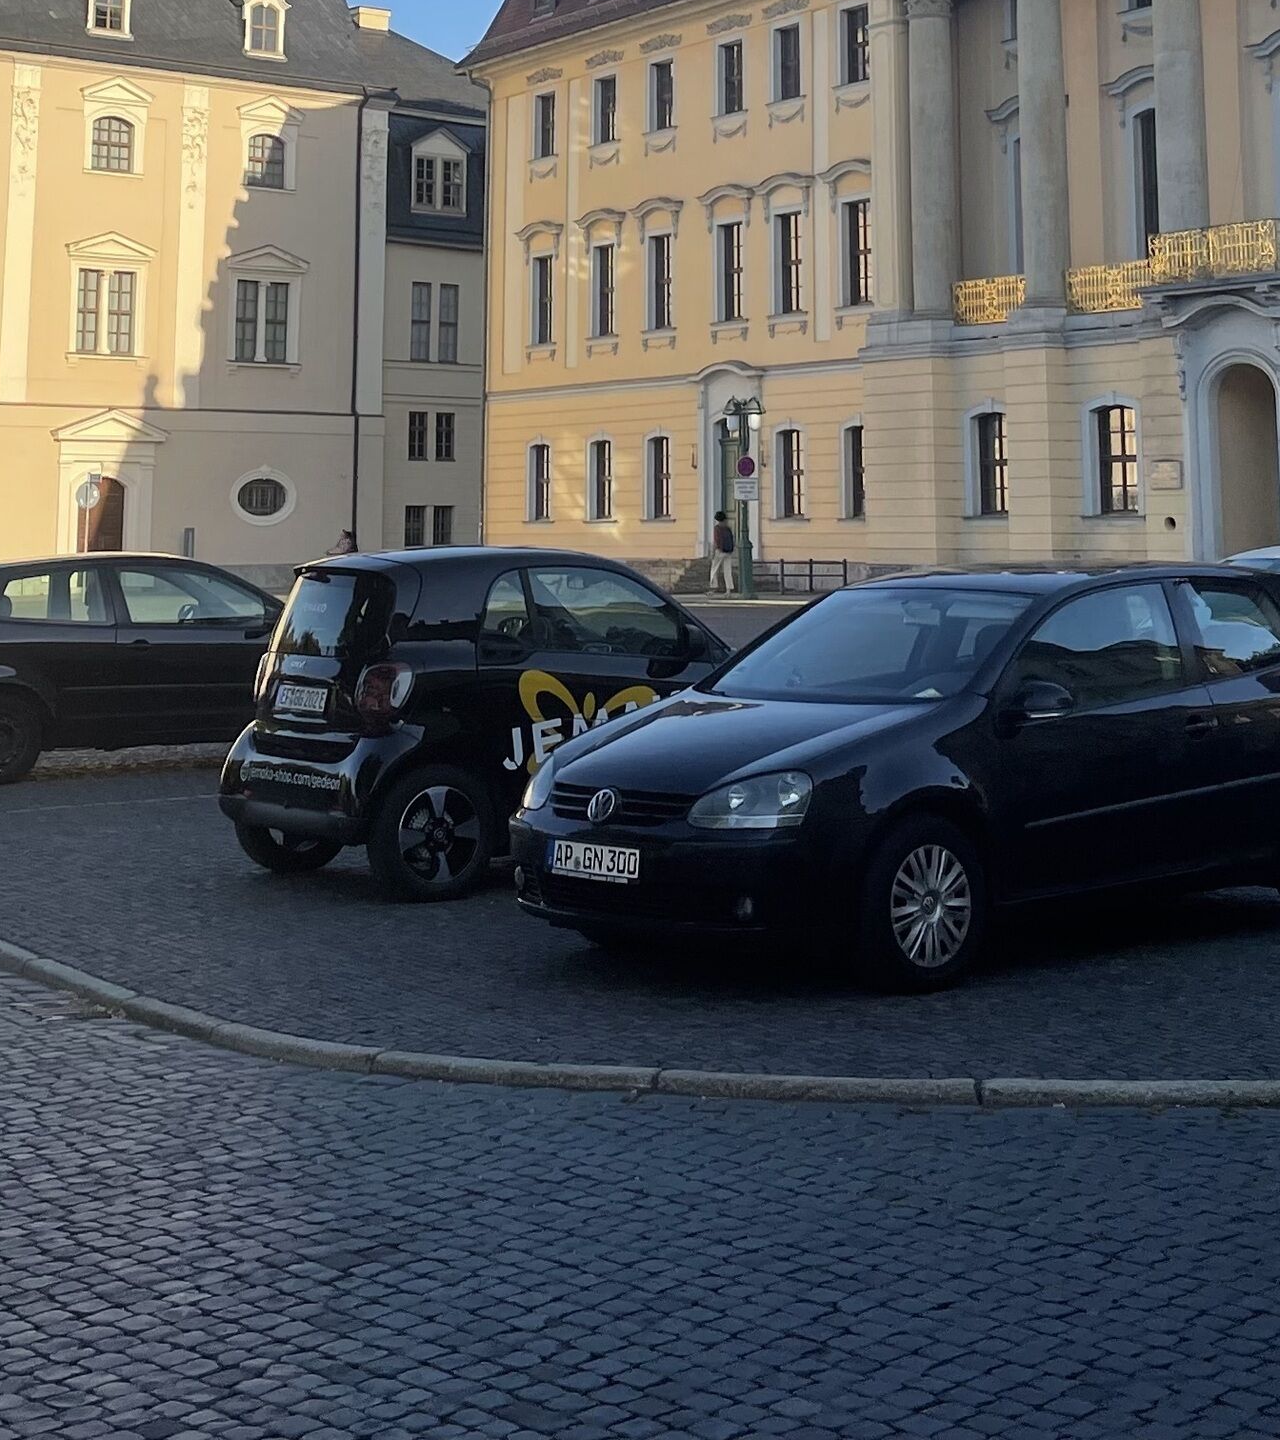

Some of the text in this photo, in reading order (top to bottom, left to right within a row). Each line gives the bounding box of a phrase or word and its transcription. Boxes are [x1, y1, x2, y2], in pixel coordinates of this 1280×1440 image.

[555, 843, 638, 875] AP GN 300
